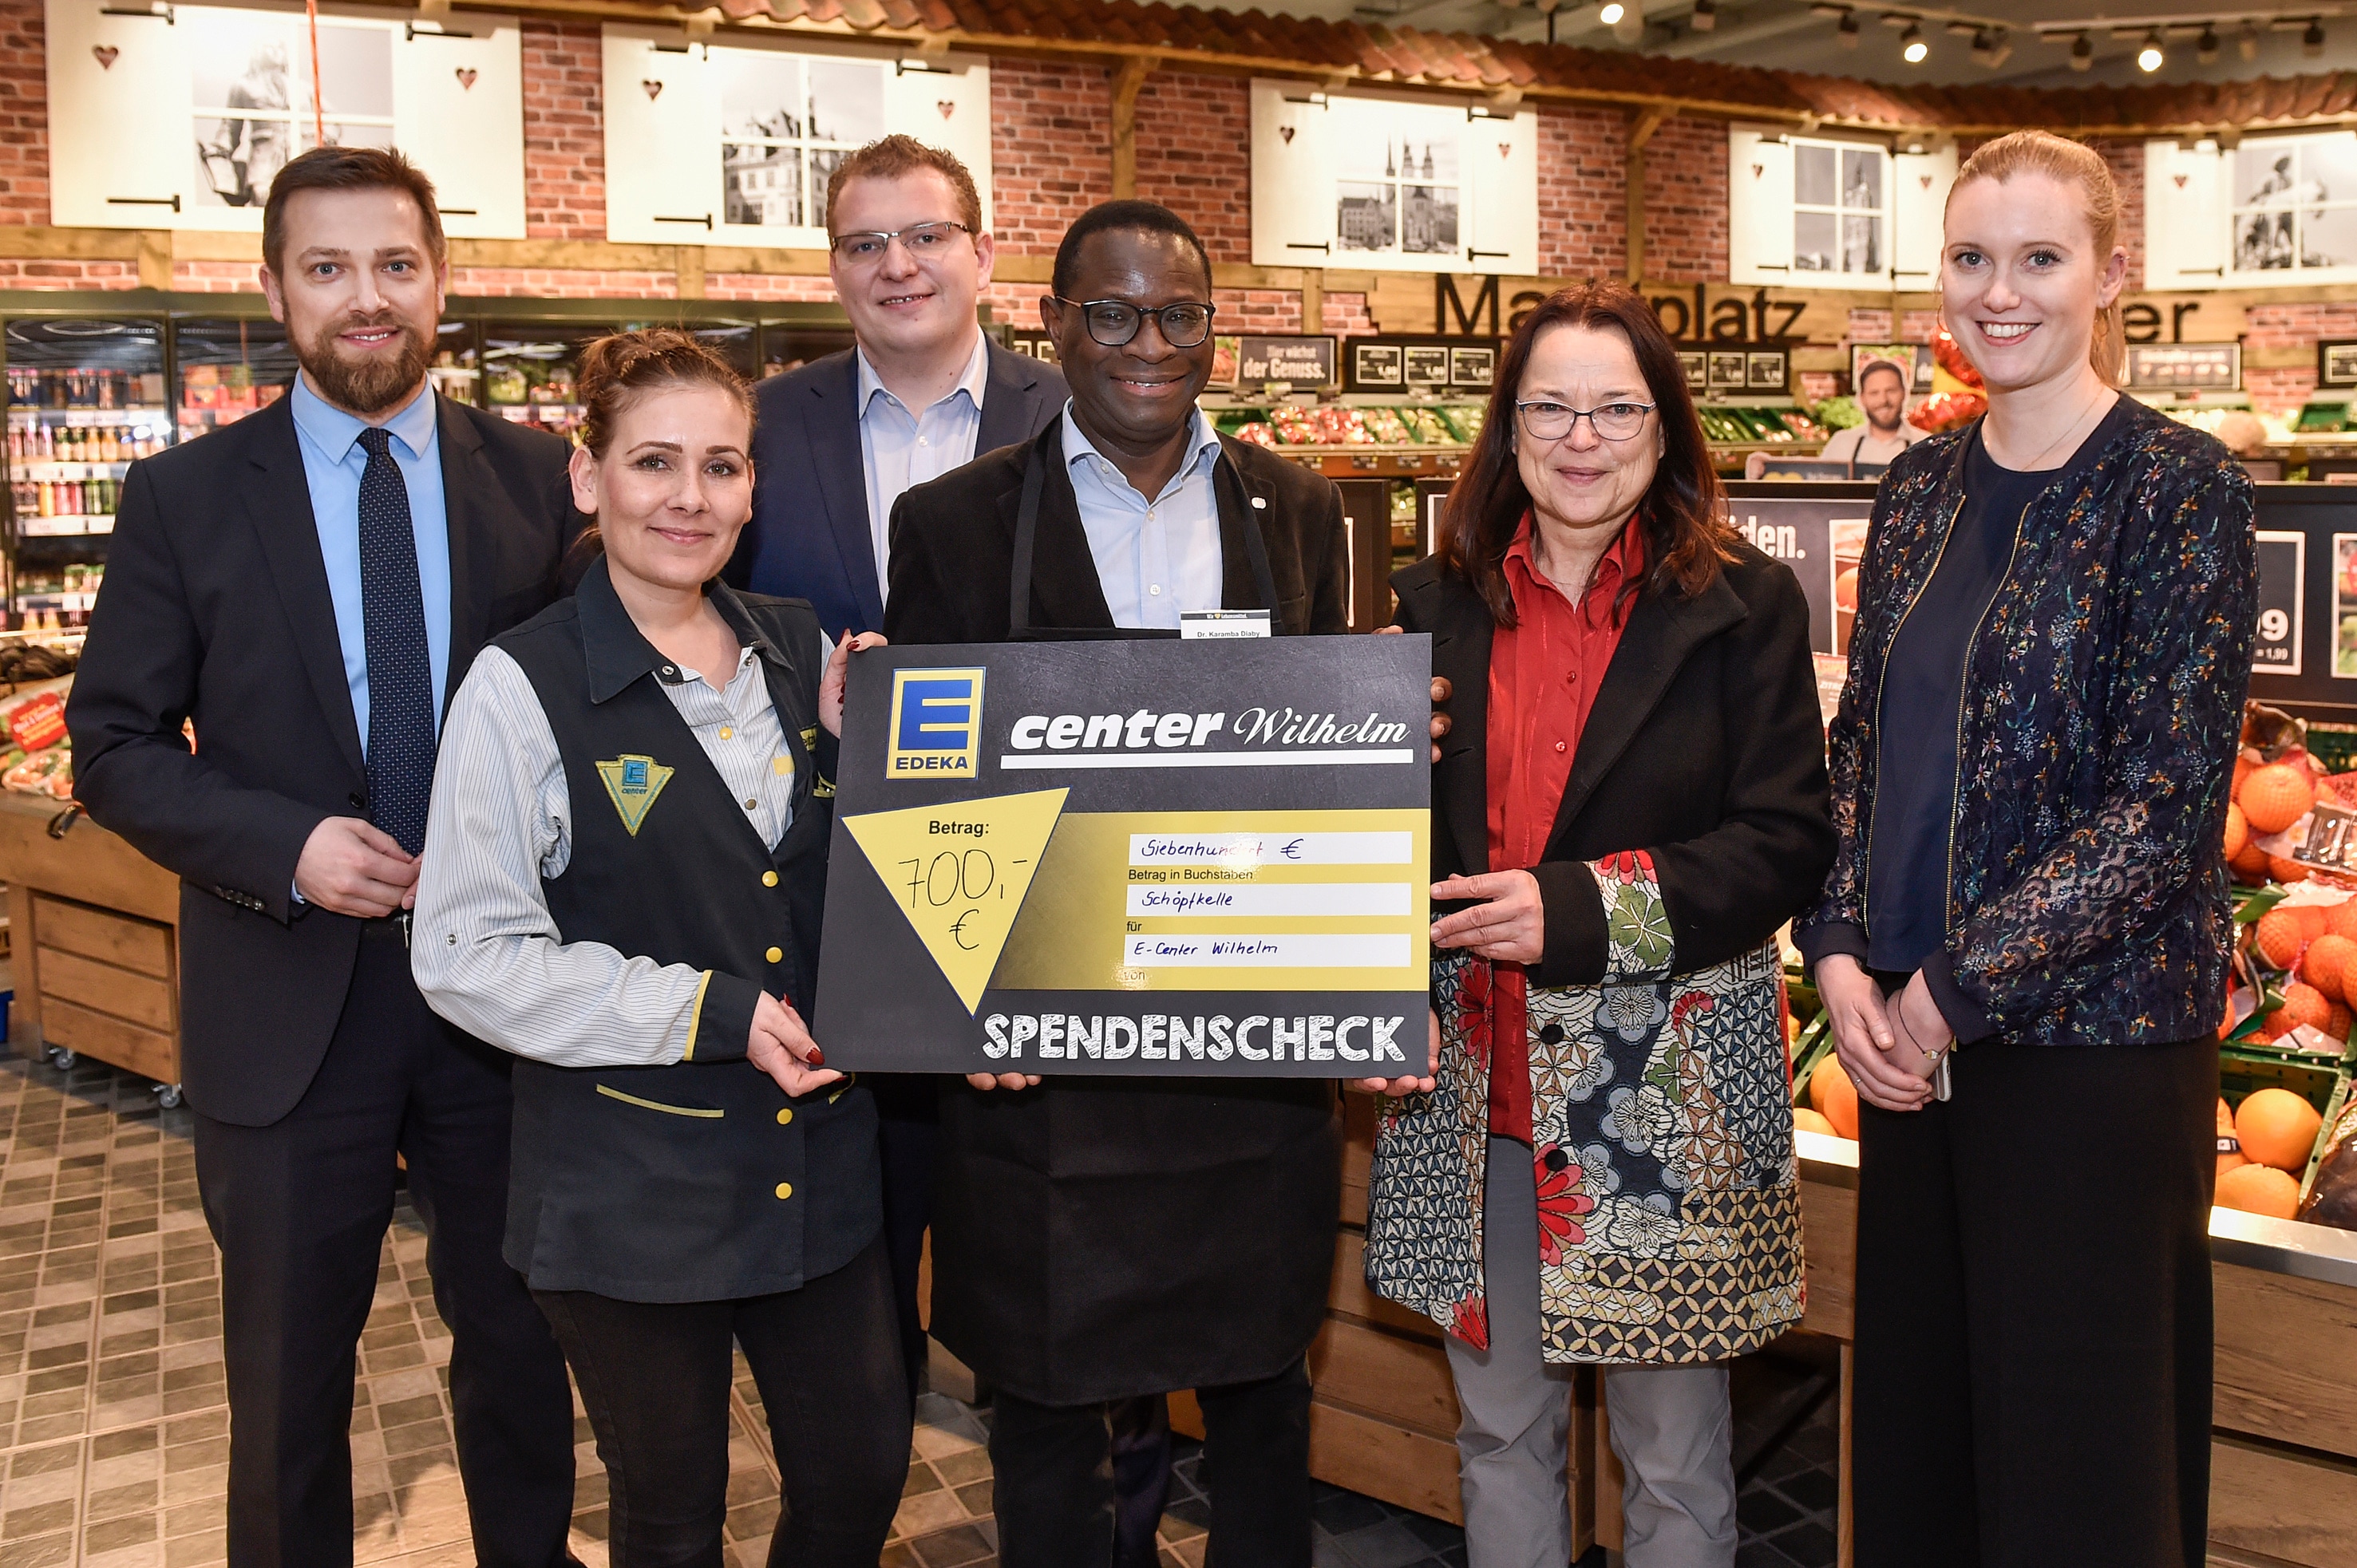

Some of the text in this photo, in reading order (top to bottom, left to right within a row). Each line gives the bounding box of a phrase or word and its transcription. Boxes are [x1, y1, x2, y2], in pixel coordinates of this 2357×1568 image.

[1244, 357, 1326, 379] der Genuss.
[1728, 515, 1806, 559] den.
[2256, 609, 2289, 642] 9
[1010, 707, 1411, 749] center Wilhelm
[896, 756, 968, 770] EDEKA
[928, 820, 990, 838] Betrag:
[1141, 838, 1304, 859] Siebenhundrt €
[898, 849, 1028, 909] 700,-
[1129, 869, 1253, 883] Betrag in Buchstaben
[948, 909, 979, 950] €
[1126, 921, 1142, 932] für
[1133, 940, 1278, 957] E-Center Wilhelm
[1124, 971, 1146, 981] von
[982, 1013, 1406, 1062] SPENDENSCHECK
